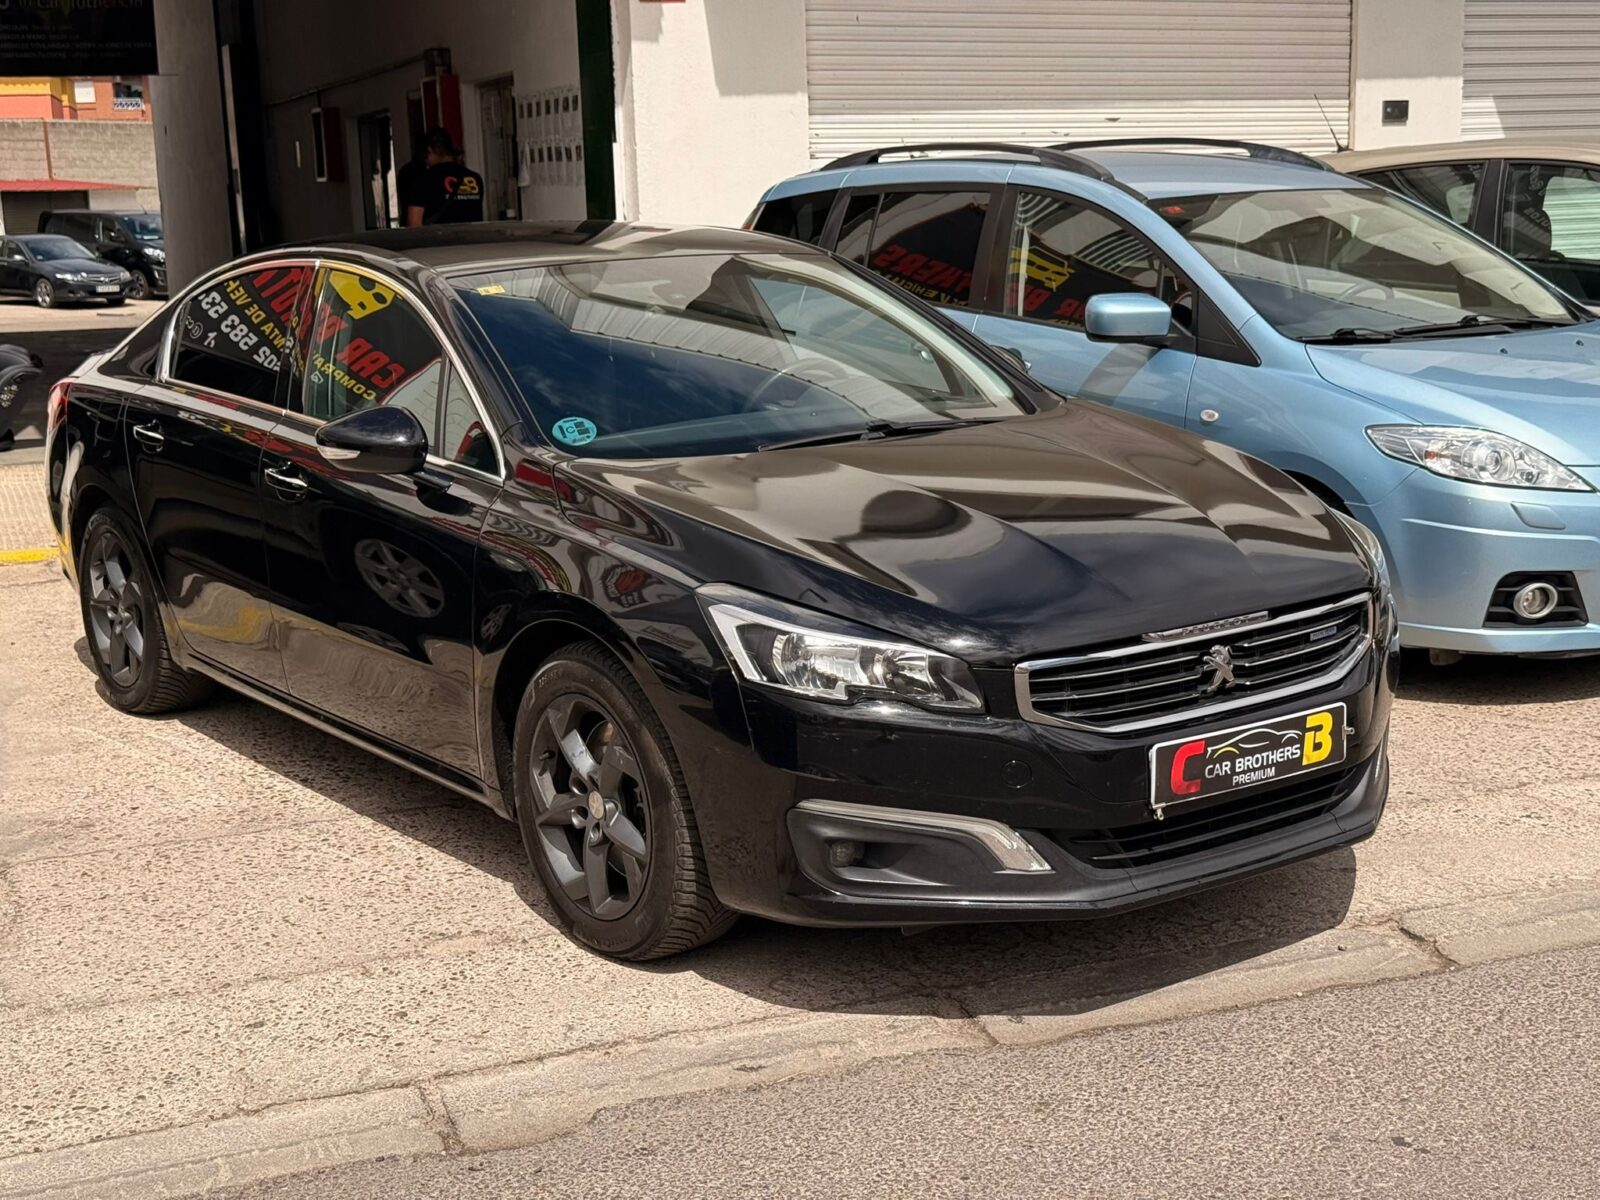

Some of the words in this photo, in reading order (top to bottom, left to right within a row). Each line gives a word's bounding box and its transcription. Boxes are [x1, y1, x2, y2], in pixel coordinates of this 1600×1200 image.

[1170, 740, 1206, 796] C
[1205, 758, 1231, 779] CAR
[1235, 743, 1301, 773] BROTHERS
[1302, 711, 1333, 766] B
[1232, 766, 1276, 786] PREMIUM
